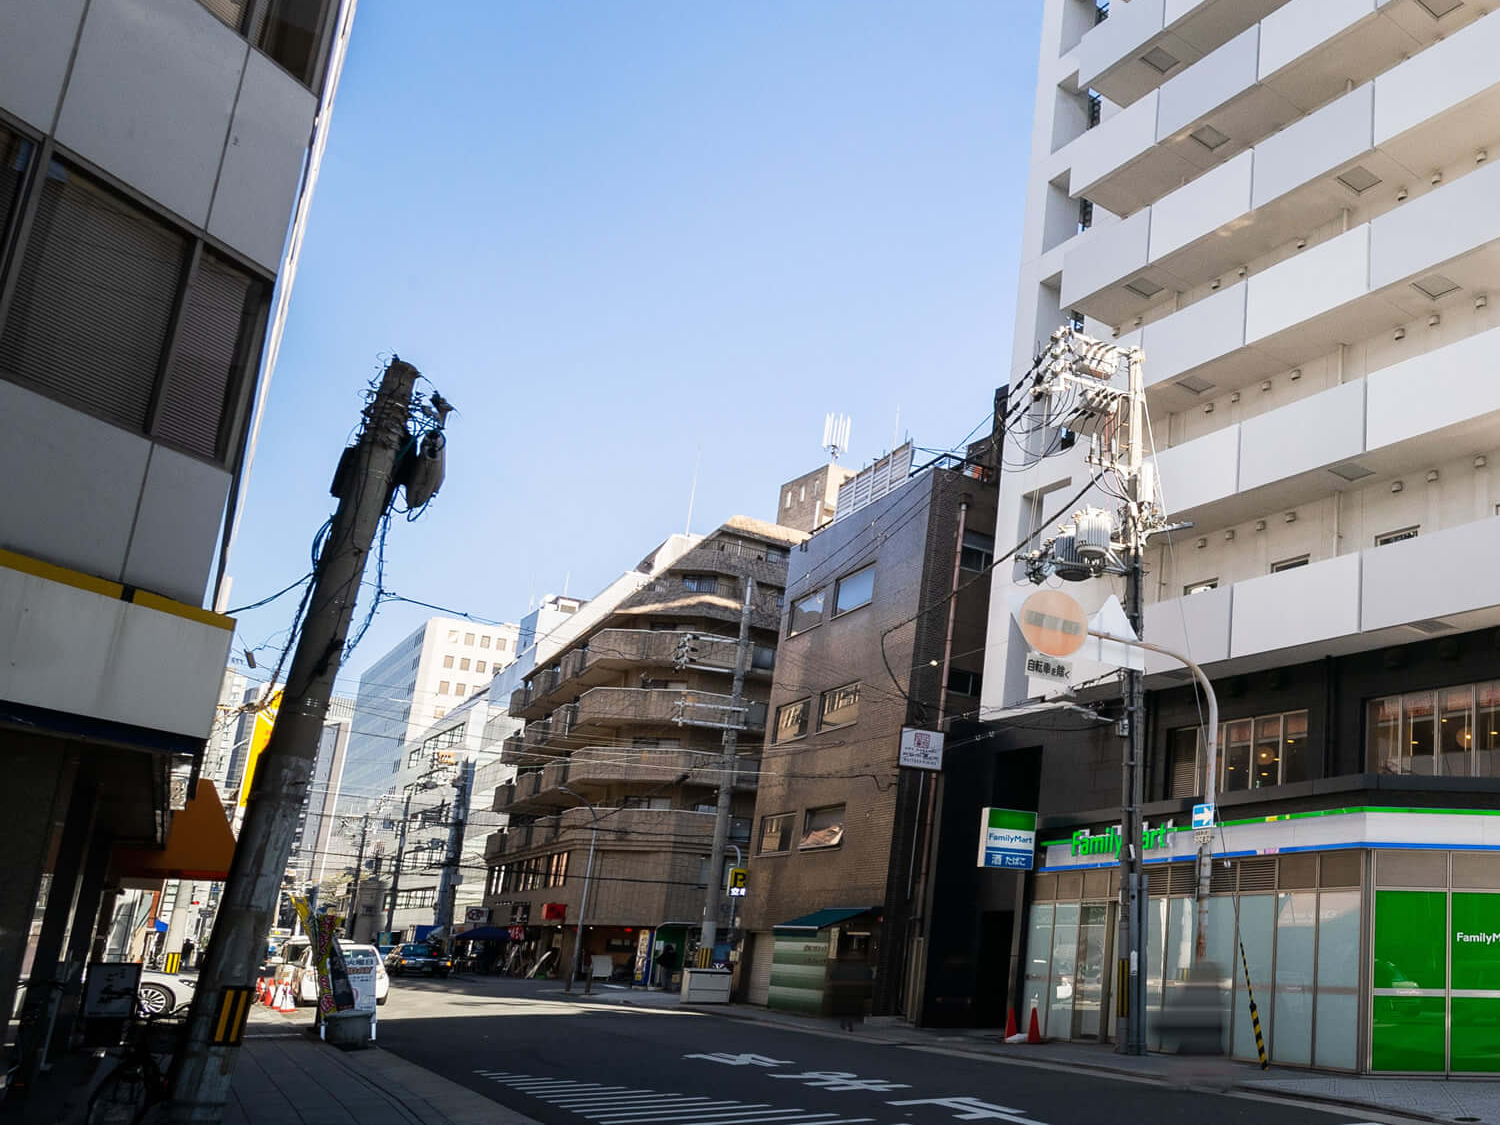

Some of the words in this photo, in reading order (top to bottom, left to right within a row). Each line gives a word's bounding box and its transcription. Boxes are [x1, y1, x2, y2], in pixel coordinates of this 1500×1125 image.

[1027, 659, 1070, 679] 自転車を除く
[988, 832, 1033, 844] FamilyMart
[1071, 822, 1168, 859] Familyart
[991, 854, 1002, 865] 酒
[1005, 856, 1027, 867] たばこ
